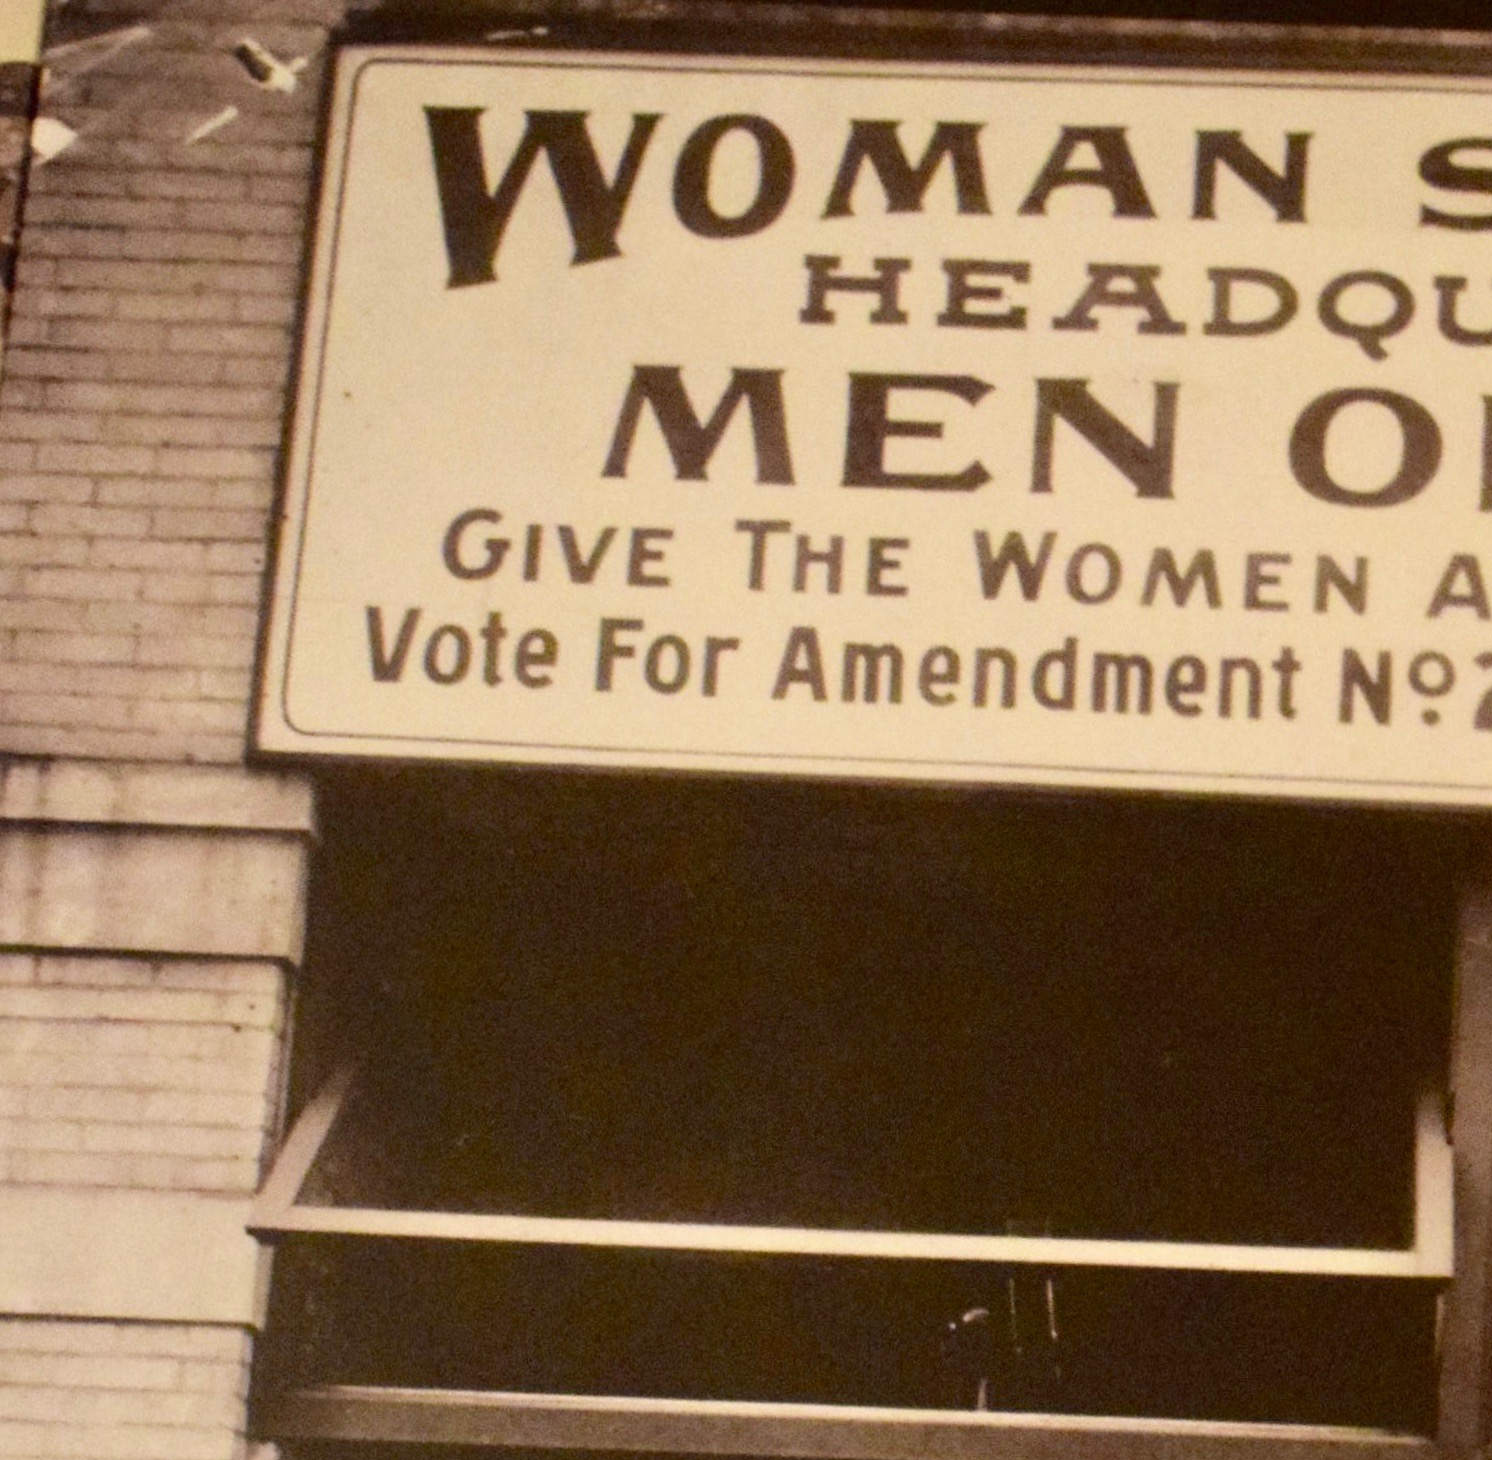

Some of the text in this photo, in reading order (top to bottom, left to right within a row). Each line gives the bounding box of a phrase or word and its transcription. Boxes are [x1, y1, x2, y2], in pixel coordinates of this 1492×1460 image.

[422, 104, 1314, 290] WOMAN
[601, 364, 1180, 500] MEN
[442, 508, 674, 587] GIVE
[735, 519, 910, 597] THE
[974, 530, 1368, 615] WOMEN
[1427, 554, 1491, 620] A
[366, 605, 558, 689] Vote
[595, 617, 740, 697] For
[772, 626, 1301, 720] Amendment
